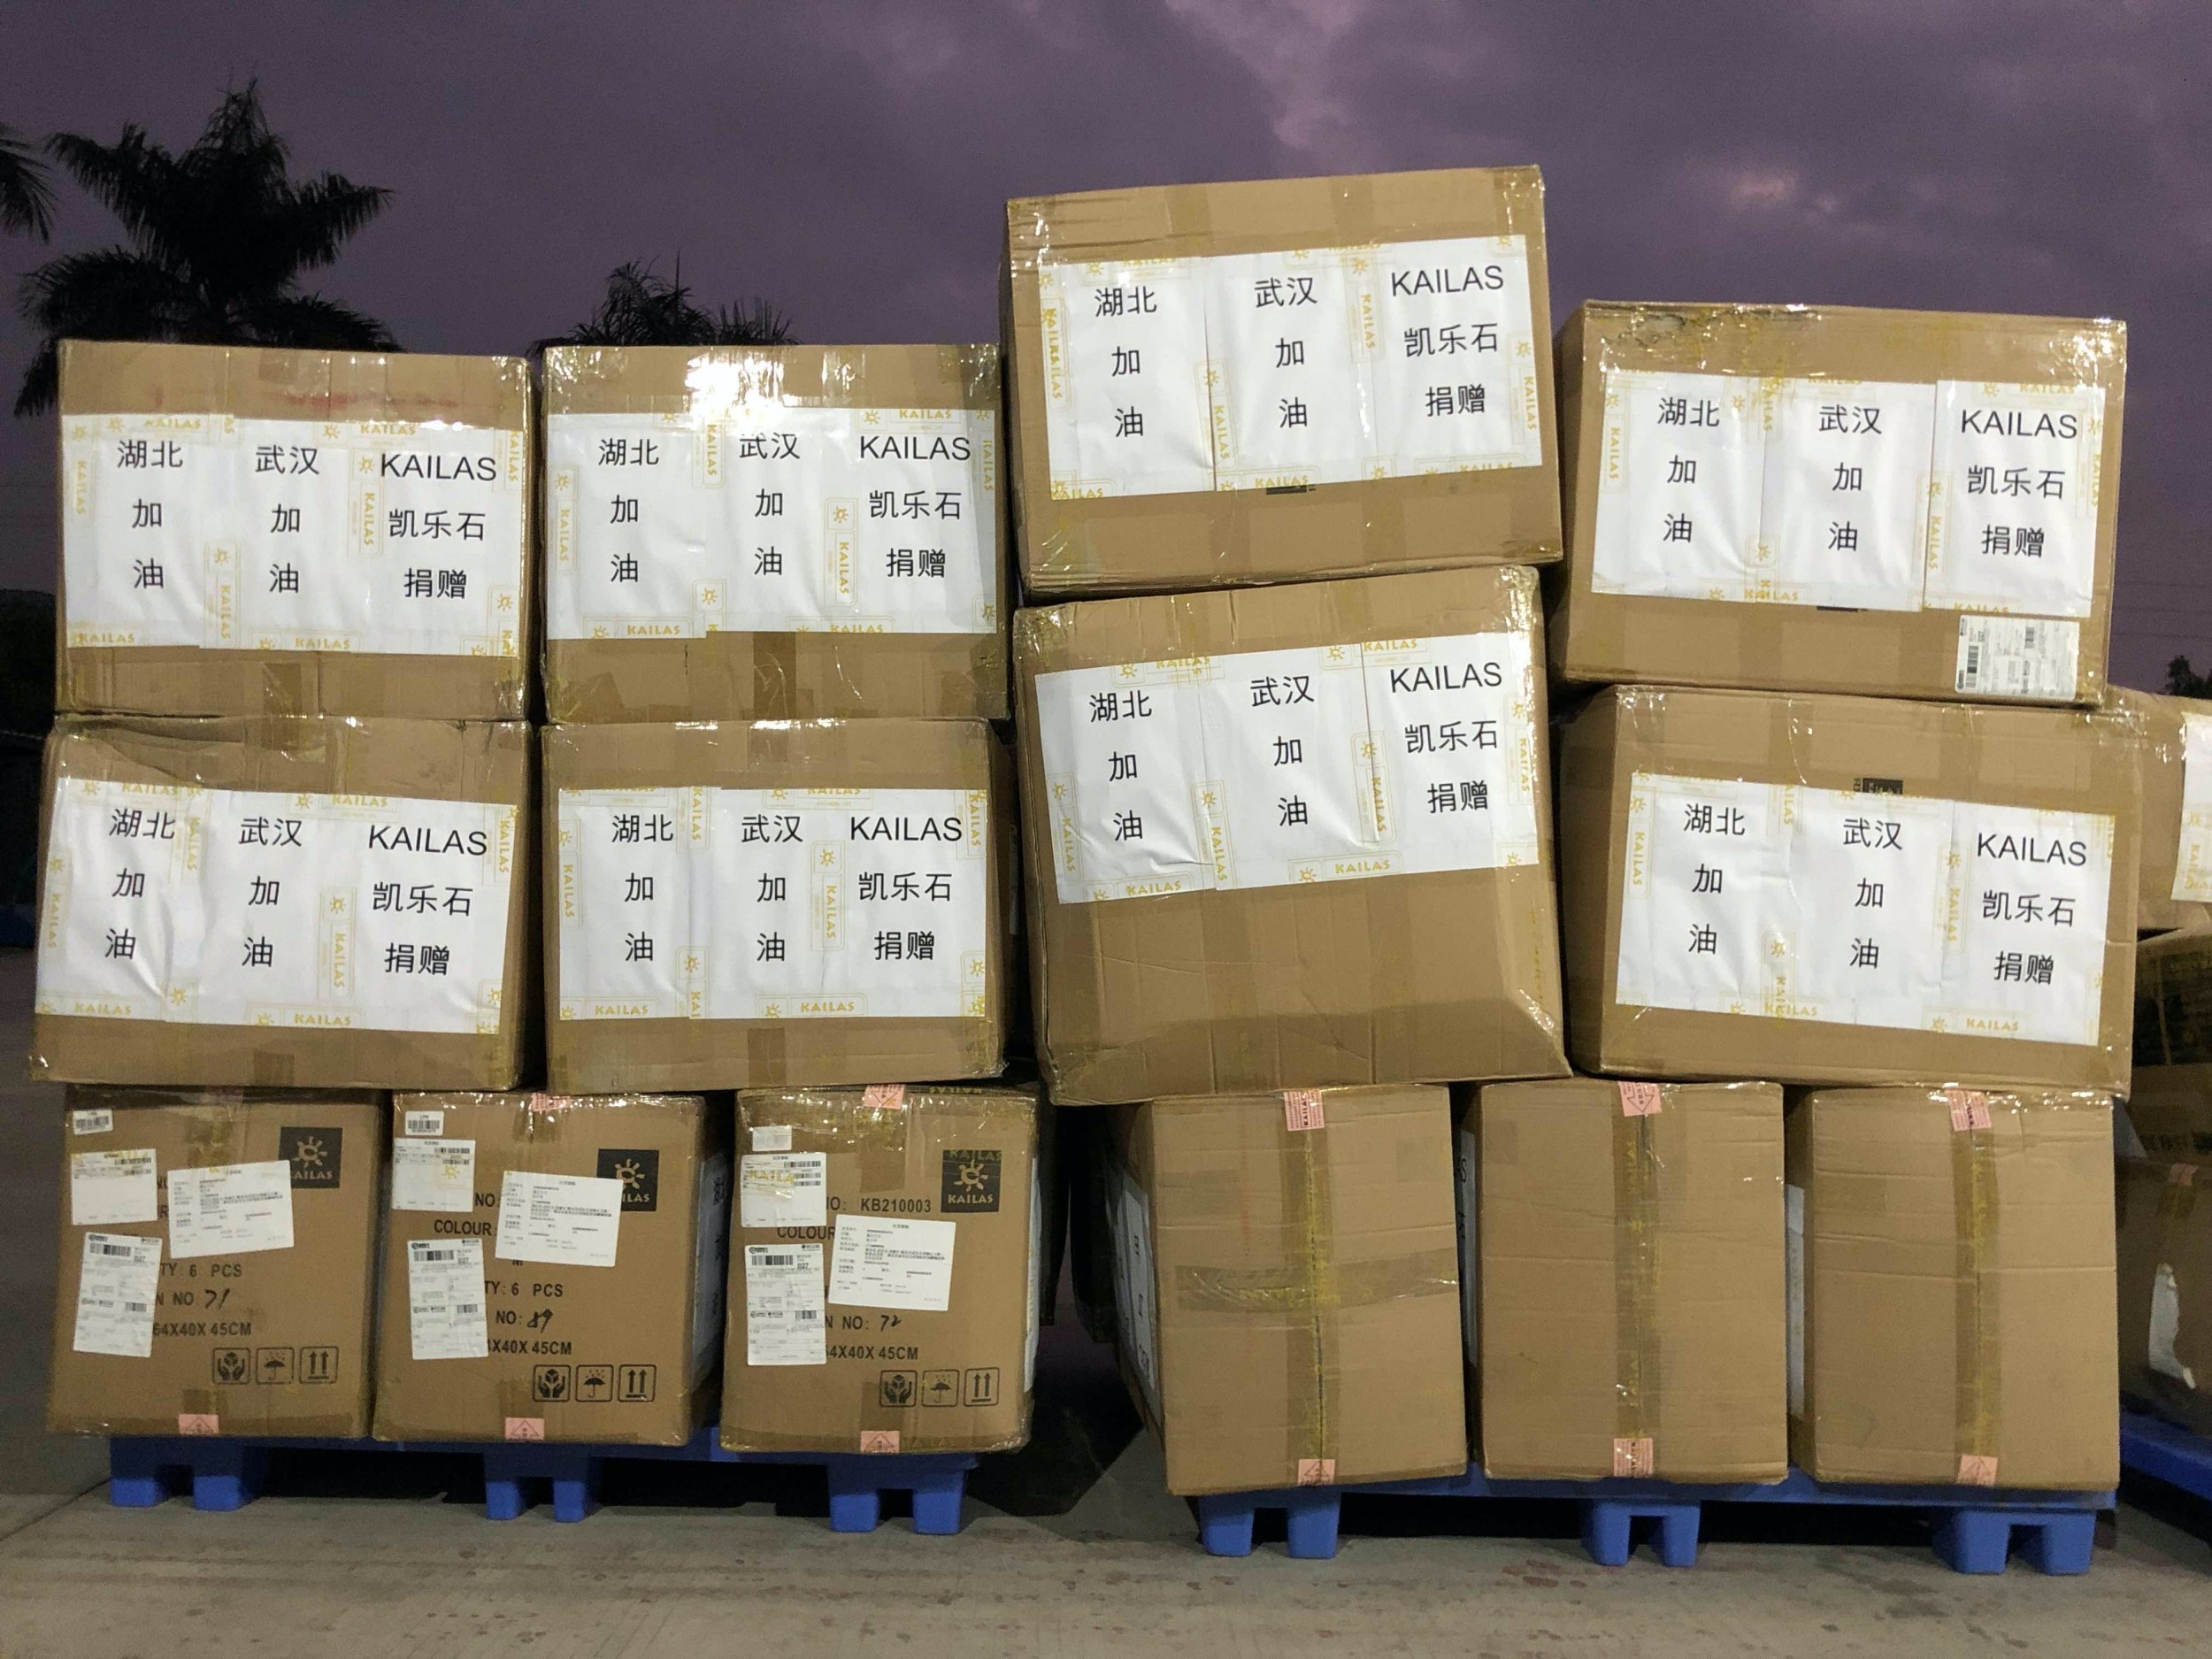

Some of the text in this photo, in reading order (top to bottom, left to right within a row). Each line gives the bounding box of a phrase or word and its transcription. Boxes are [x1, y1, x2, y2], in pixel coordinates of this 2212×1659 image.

[1255, 277, 1317, 308] 武汉
[1392, 265, 1503, 296] KAILAS
[1094, 286, 1157, 317] 湖北
[1362, 295, 1376, 348] KAILAS
[1275, 338, 1304, 368] 加
[1404, 323, 1497, 357] 凯乐石
[1111, 346, 1141, 377] 加
[900, 411, 951, 419] KAILAS
[1279, 397, 1308, 428] 油
[1425, 384, 1485, 417] 捐赠
[1525, 378, 1536, 429] KAILAS
[1658, 397, 1719, 426] 湖北
[361, 426, 416, 434] KAILAS
[1115, 406, 1143, 437] 油
[1214, 405, 1230, 459] KAILAS
[1820, 404, 1881, 434] 武汉
[1962, 410, 2078, 439] KAILAS
[118, 440, 183, 468] 湖北
[256, 444, 319, 474] 武汉
[510, 432, 519, 481] KAILAS
[598, 438, 659, 465] 湖北
[707, 425, 717, 475] KAILAS
[740, 434, 800, 459] 武汉
[860, 435, 971, 461] KAILAS
[1609, 428, 1619, 479] KAILAS
[381, 453, 496, 481] KAILAS
[983, 441, 993, 491] KAILAS
[1667, 455, 1696, 483] 加
[1832, 463, 1863, 491] 加
[77, 462, 87, 515] KAILAS
[1256, 476, 1308, 488] KAILAS
[1968, 465, 2064, 499] 凯乐石
[132, 498, 162, 528] 加
[271, 503, 300, 533] 加
[610, 495, 638, 524] 加
[755, 488, 783, 517] 加
[869, 490, 962, 520] 凯乐石
[364, 494, 374, 545] KAILAS
[388, 509, 486, 541] 凯乐石
[1663, 513, 1693, 542] 油
[560, 510, 569, 561] KAILAS
[1829, 521, 1858, 551] 油
[1930, 517, 1940, 569] KAILAS
[1980, 525, 2045, 557] 捐赠
[134, 558, 164, 588] 油
[611, 552, 639, 583] 油
[754, 546, 782, 575] 油
[840, 542, 849, 594] KAILAS
[886, 548, 946, 578] 捐赠
[269, 563, 299, 594] 油
[403, 567, 467, 599] 捐赠
[220, 585, 229, 639] KAILAS
[296, 639, 349, 649] KAILAS
[627, 625, 680, 634] KAILAS
[1363, 639, 1417, 651] KAILAS
[1250, 675, 1315, 707] 武汉
[1390, 662, 1502, 693] KAILAS
[1089, 689, 1152, 723] 湖北
[1272, 735, 1302, 766] 加
[1404, 720, 1497, 754] 凯乐石
[1108, 751, 1138, 782] 加
[1518, 738, 1530, 791] KAILAS
[333, 796, 388, 807] KAILAS
[1278, 795, 1308, 826] 油
[1427, 780, 1488, 814] 捐赠
[109, 808, 175, 840] 湖北
[611, 813, 674, 843] 湖北
[693, 787, 702, 840] KAILAS
[741, 814, 803, 843] 武汉
[850, 817, 963, 841] KAILAS
[1113, 810, 1143, 841] 油
[1684, 803, 1745, 835] 湖北
[239, 817, 302, 847] 武汉
[369, 825, 488, 856] KAILAS
[499, 821, 510, 873] KAILAS
[1063, 818, 1075, 871] KAILAS
[1844, 818, 1902, 850] 武汉
[1212, 828, 1227, 880] KAILAS
[1632, 833, 1645, 885] KAILAS
[1978, 833, 2086, 866] KAILAS
[1336, 860, 1389, 873] KAILAS
[1692, 864, 1723, 894] 加
[111, 868, 145, 898] 加
[248, 875, 280, 906] 加
[564, 865, 574, 918] KAILAS
[625, 872, 654, 902] 加
[757, 872, 786, 902] 加
[858, 872, 952, 902] 凯乐石
[1126, 881, 1180, 894] KAILAS
[1855, 878, 1884, 908] 加
[373, 881, 473, 917] 凯乐石
[826, 887, 836, 938] KAILAS
[1983, 890, 2076, 926] 凯乐石
[48, 895, 59, 948] KAILAS
[1948, 889, 1959, 942] KAILAS
[104, 928, 136, 960] 油
[242, 936, 273, 967] 油
[625, 931, 653, 962] 油
[757, 931, 785, 962] 油
[873, 930, 935, 961] 捐赠
[1688, 924, 1717, 955] 油
[1850, 938, 1879, 969] 油
[334, 933, 345, 987] KAILAS
[384, 942, 450, 976] 捐赠
[1994, 951, 2054, 985] 捐赠
[74, 1004, 131, 1014] KAILAS
[296, 1015, 350, 1025] KAILAS
[595, 1005, 648, 1015] KAILAS
[801, 1002, 854, 1011] KAILAS
[1966, 1019, 2018, 1031] KAILAS
[622, 1194, 650, 1202] ILAS
[861, 1197, 932, 1213] KB210003
[948, 1194, 994, 1203] KAILAS
[189, 1263, 242, 1278] 6 PCS
[484, 1280, 564, 1297] TY: 6 PCS
